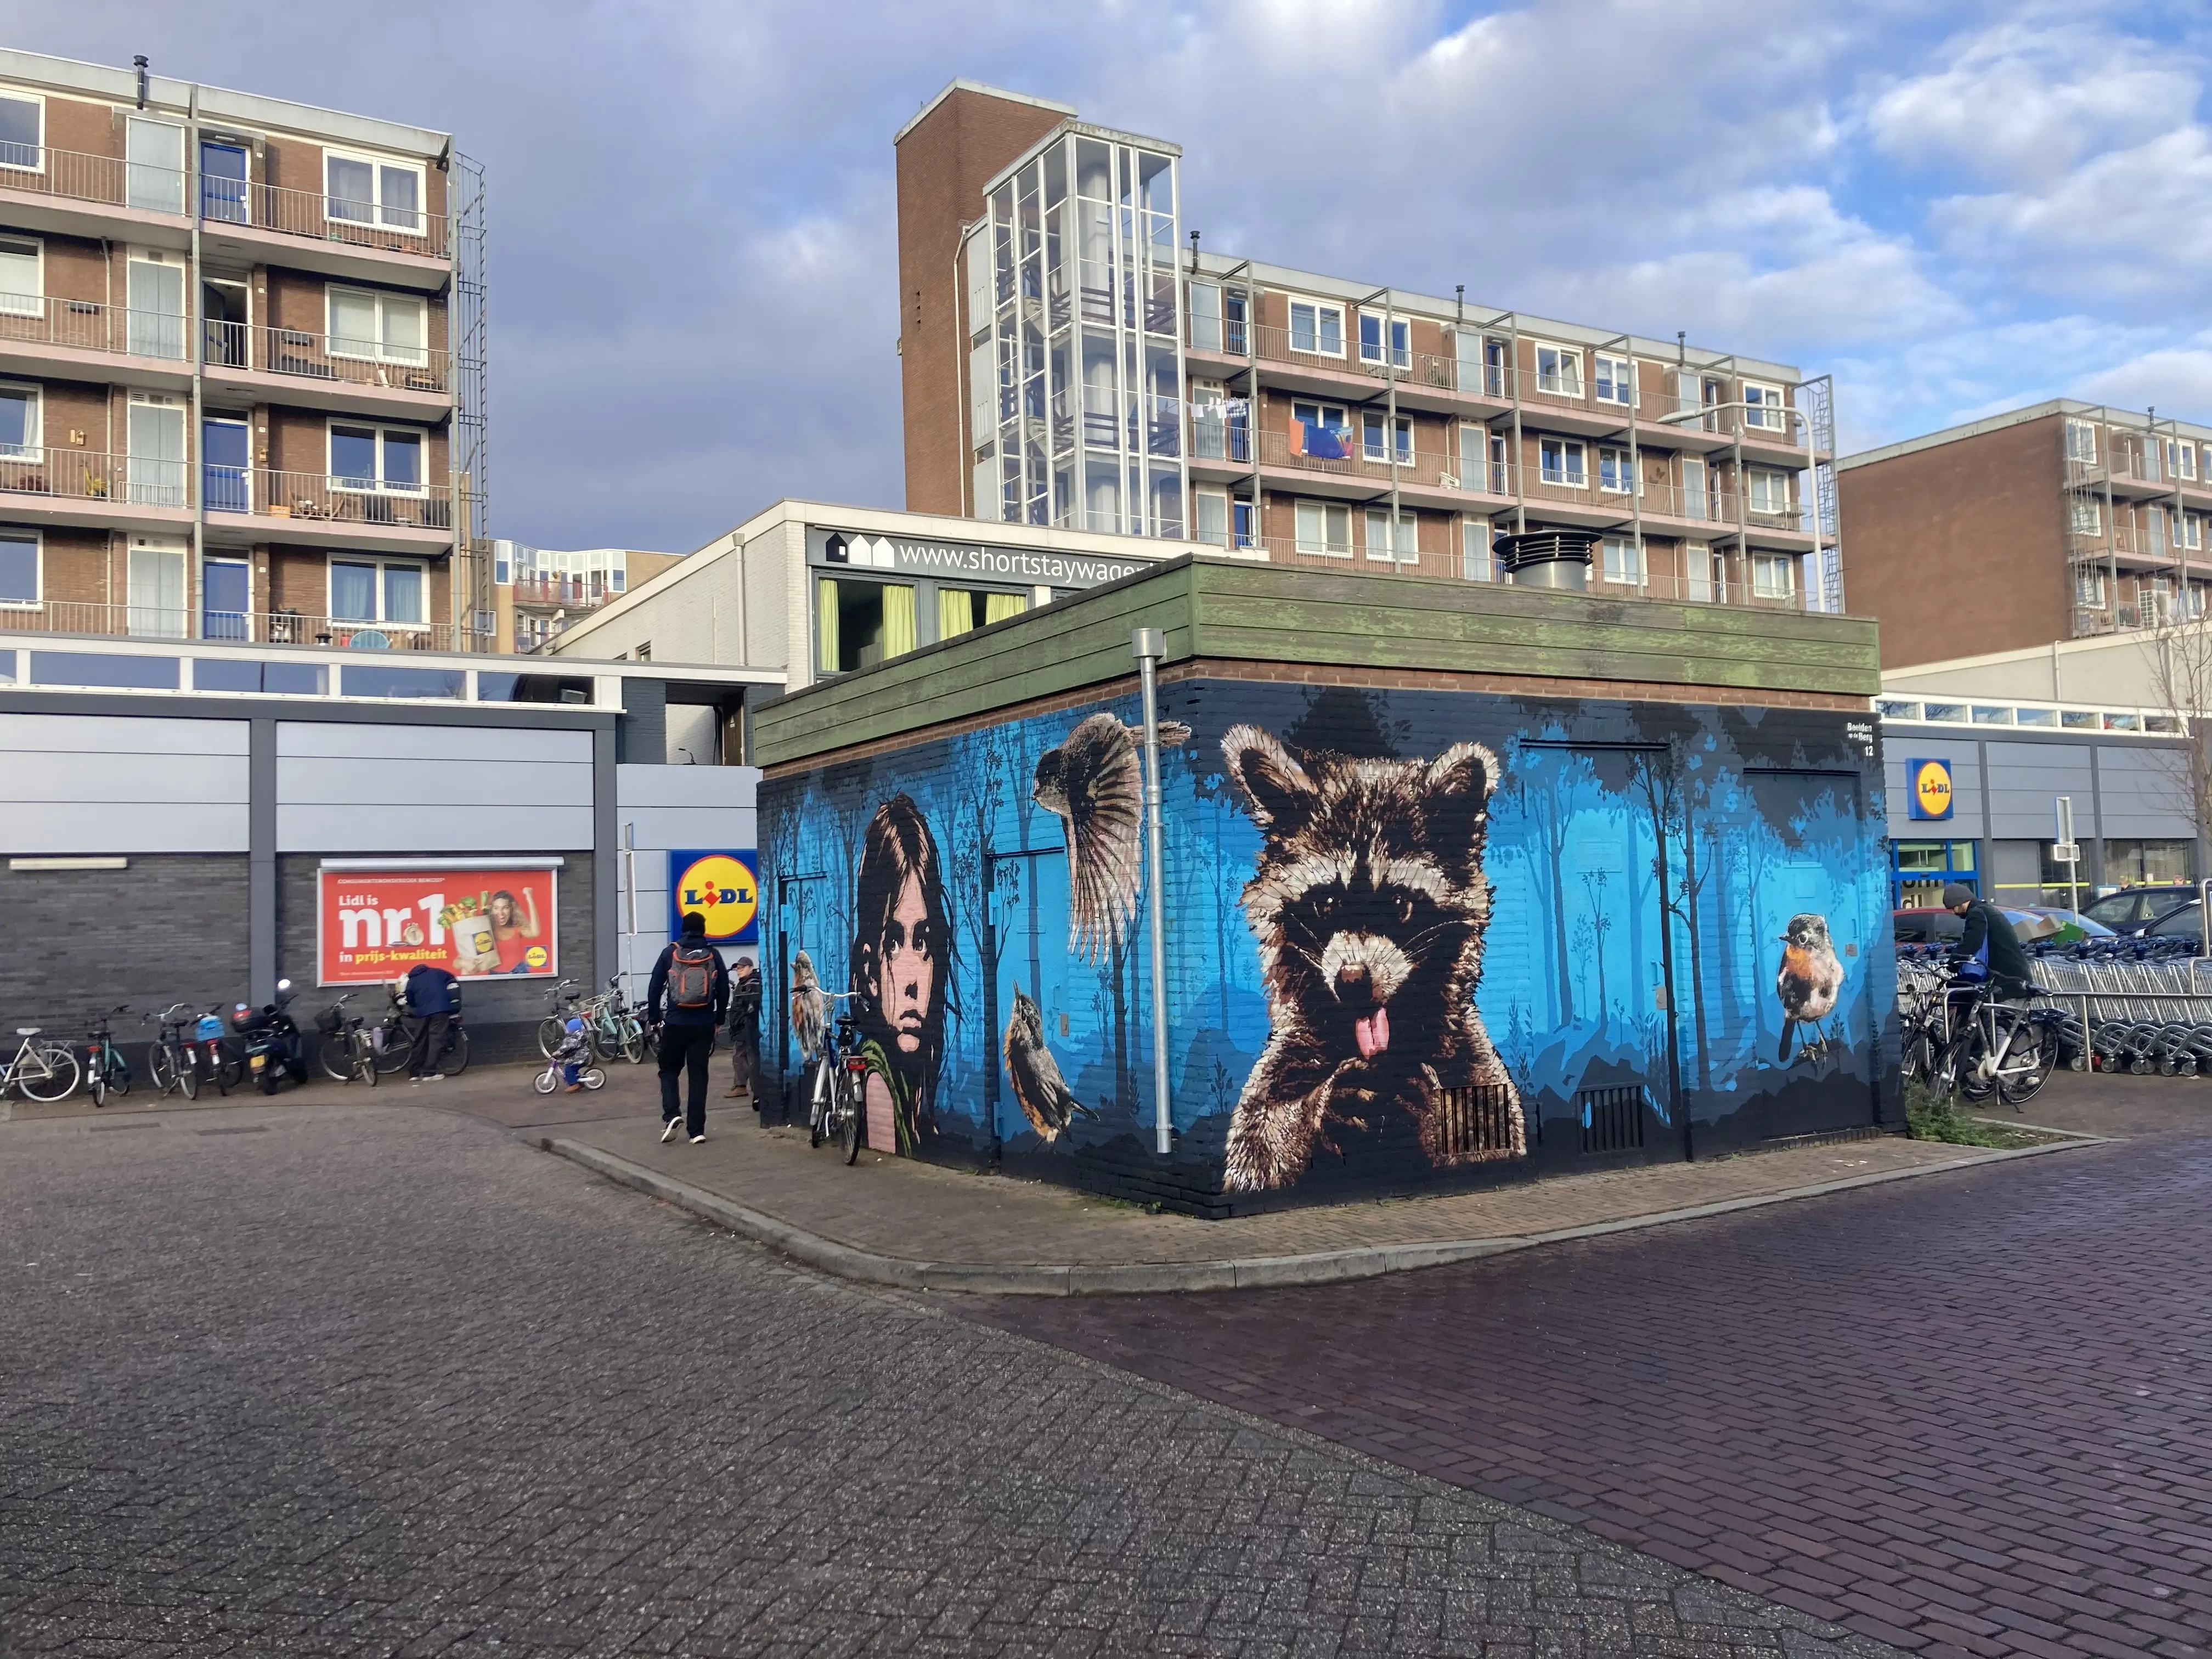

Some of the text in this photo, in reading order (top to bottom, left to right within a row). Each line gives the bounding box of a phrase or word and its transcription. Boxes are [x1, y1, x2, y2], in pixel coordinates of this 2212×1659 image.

[900, 545, 1154, 584] www.shortstaywage
[1847, 722, 1872, 732] Beelden
[1859, 732, 1873, 743] Berg
[1865, 746, 1874, 756] 12
[338, 894, 379, 906] Lidl is
[339, 948, 448, 964] in prijs-kwaliteit
